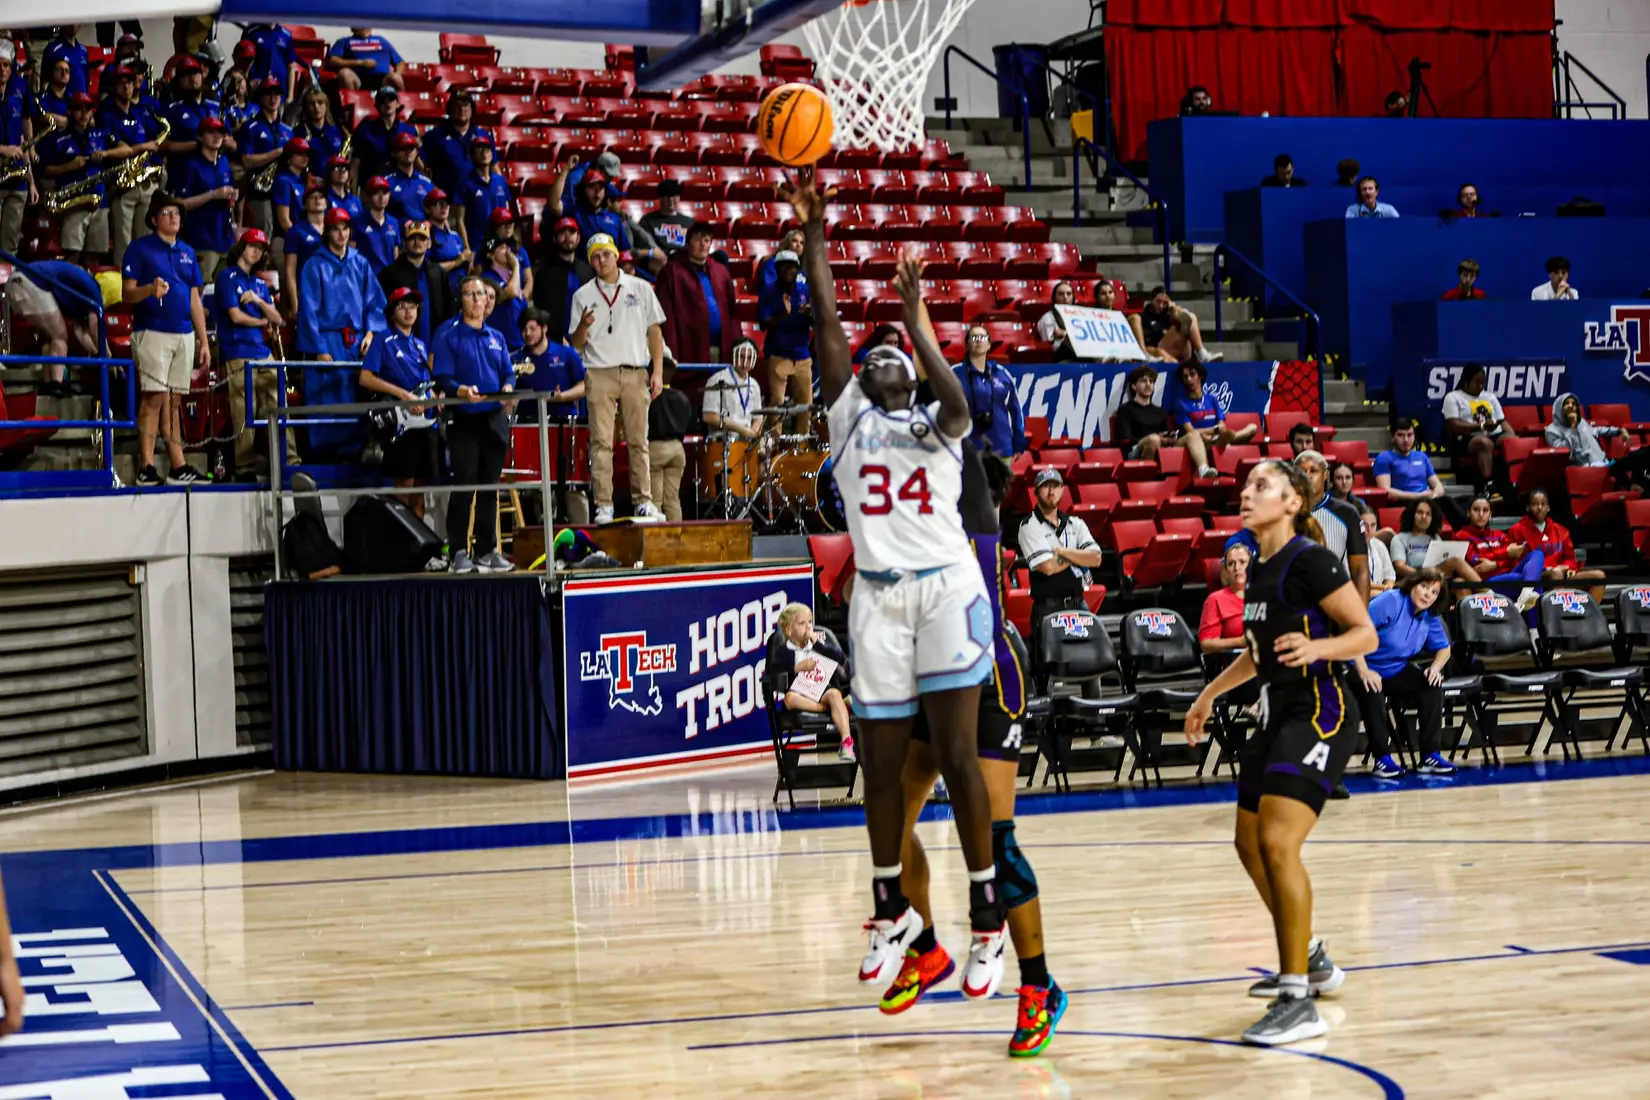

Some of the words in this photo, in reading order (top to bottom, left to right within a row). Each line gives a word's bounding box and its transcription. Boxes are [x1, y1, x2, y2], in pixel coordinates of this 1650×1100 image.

[1071, 318, 1136, 344] SILVIA
[1585, 322, 1625, 351] LA
[1427, 366, 1566, 400] STDENT
[859, 464, 934, 516] 34
[581, 650, 609, 681] LA
[600, 630, 677, 694] TECH
[1302, 741, 1331, 772] A
